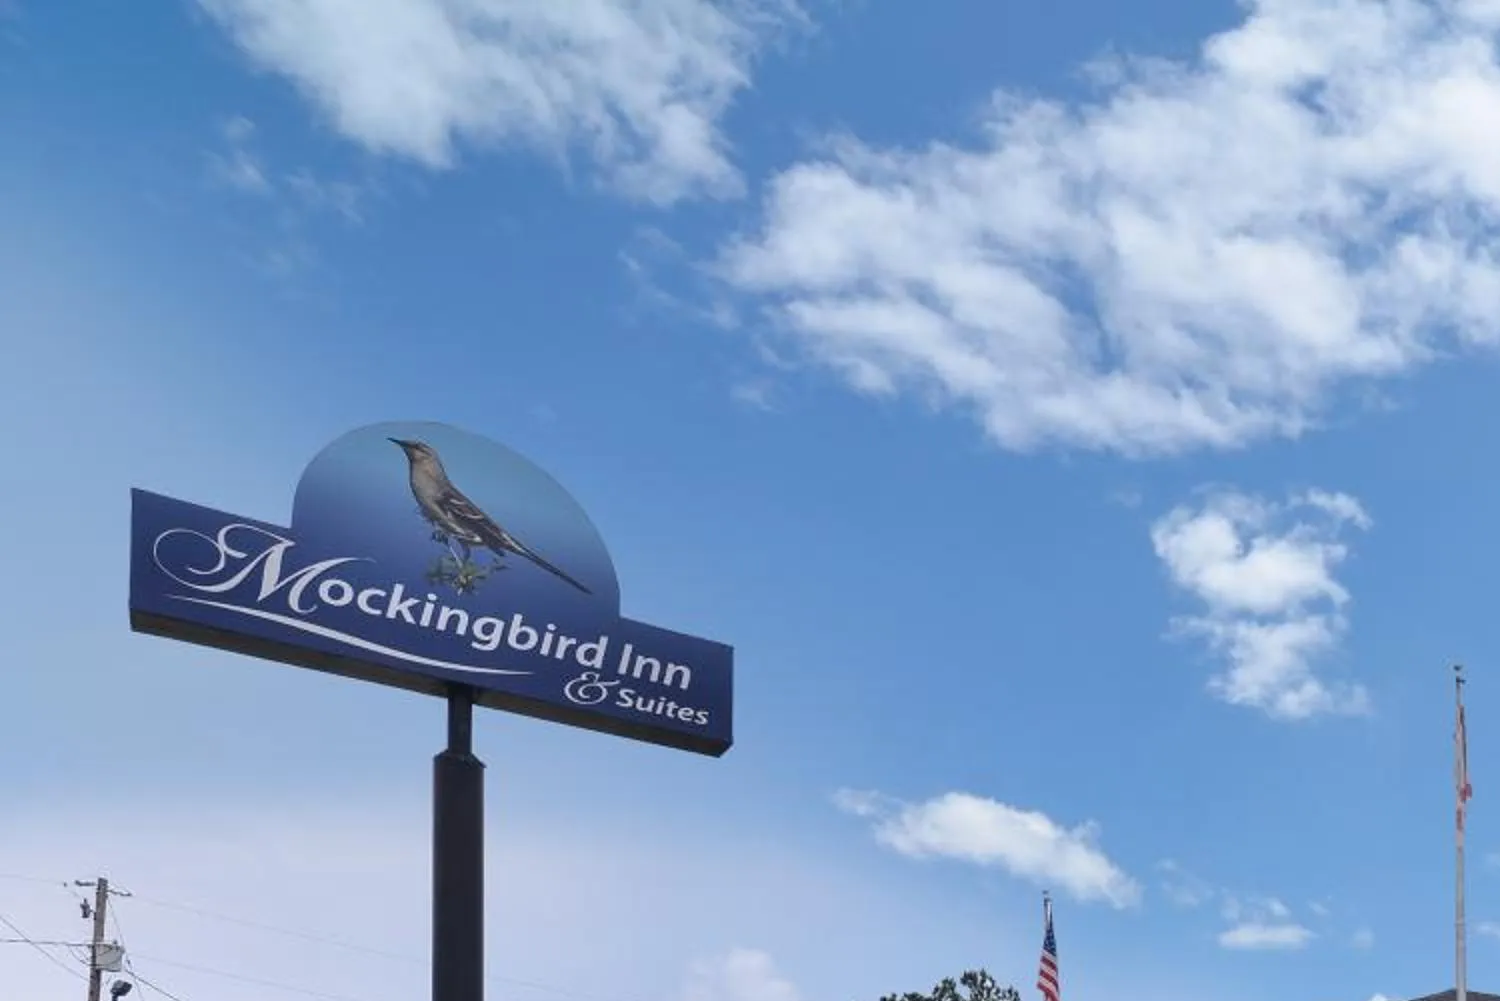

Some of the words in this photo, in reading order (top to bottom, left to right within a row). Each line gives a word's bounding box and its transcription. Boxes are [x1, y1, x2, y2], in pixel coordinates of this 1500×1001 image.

[153, 523, 606, 670] Mockingbird
[617, 643, 692, 690] Inn
[564, 671, 623, 705] &
[616, 687, 710, 727] Suites
